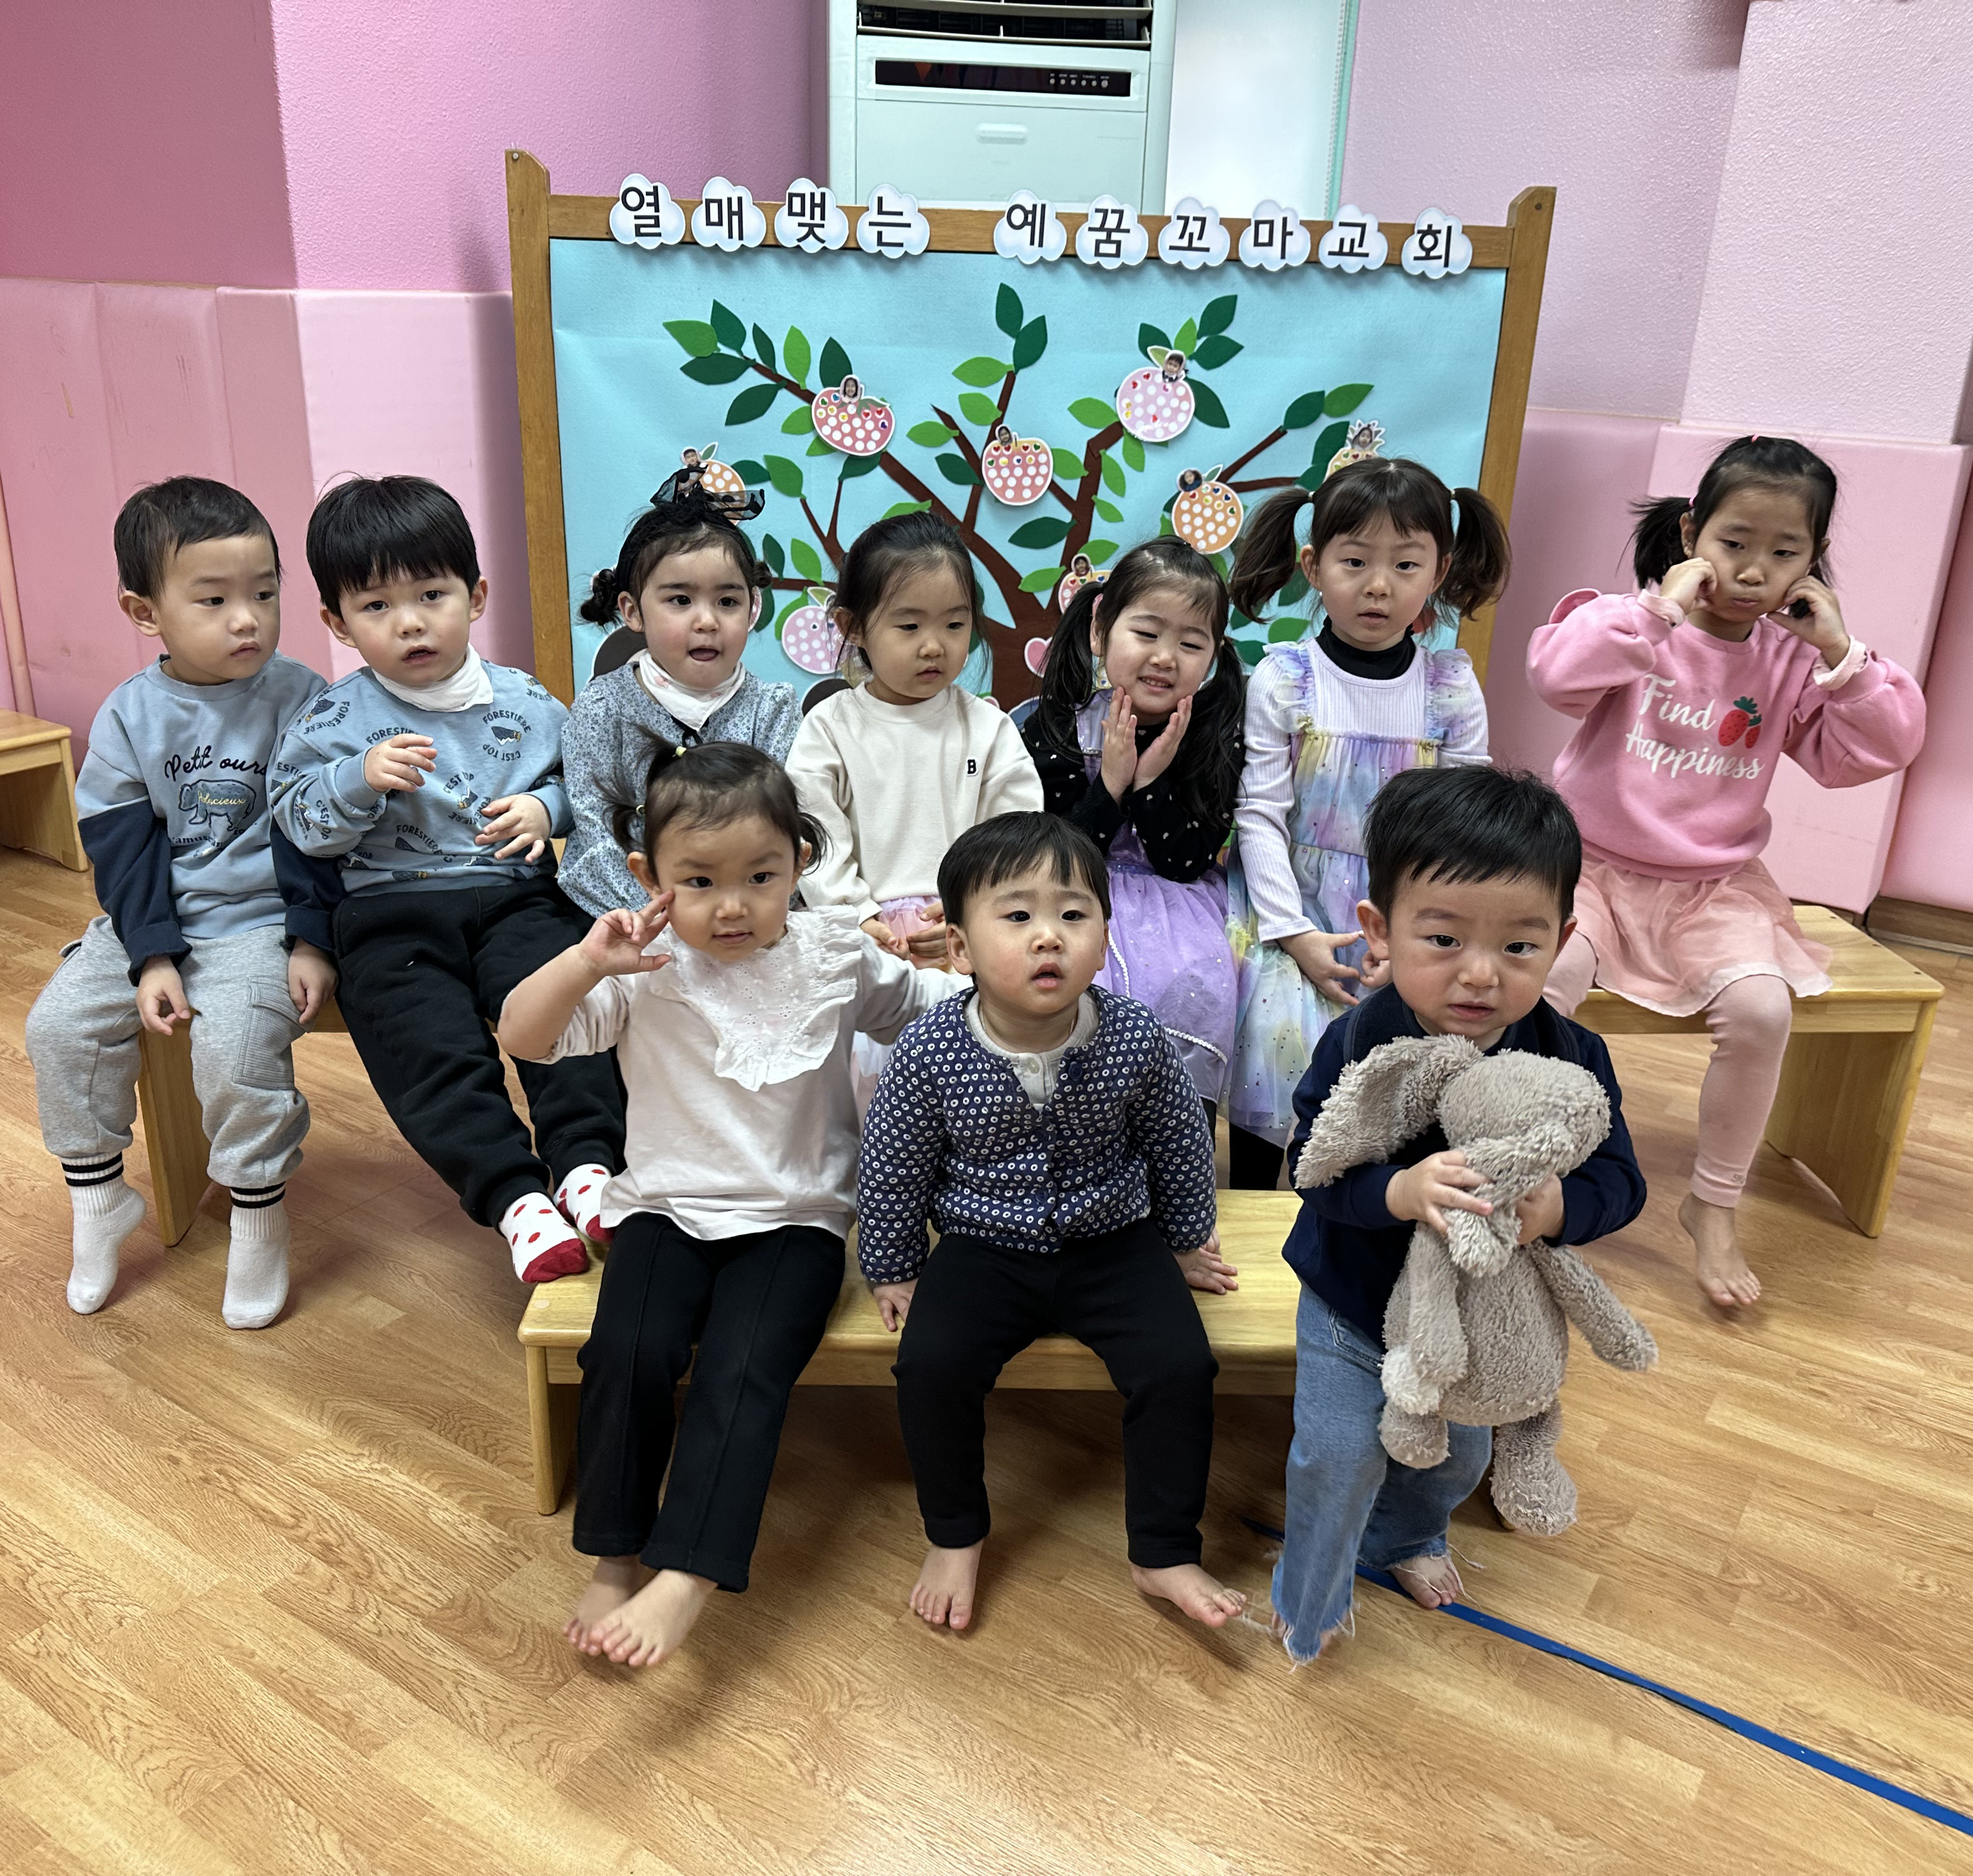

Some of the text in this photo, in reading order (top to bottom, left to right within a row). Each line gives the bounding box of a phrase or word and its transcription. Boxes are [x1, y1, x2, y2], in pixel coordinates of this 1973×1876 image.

[1639, 673, 1717, 731] Find
[483, 710, 532, 733] FORESTIERE
[482, 744, 499, 759] TOP
[1625, 718, 1766, 779] Happiness
[967, 758, 978, 775] B
